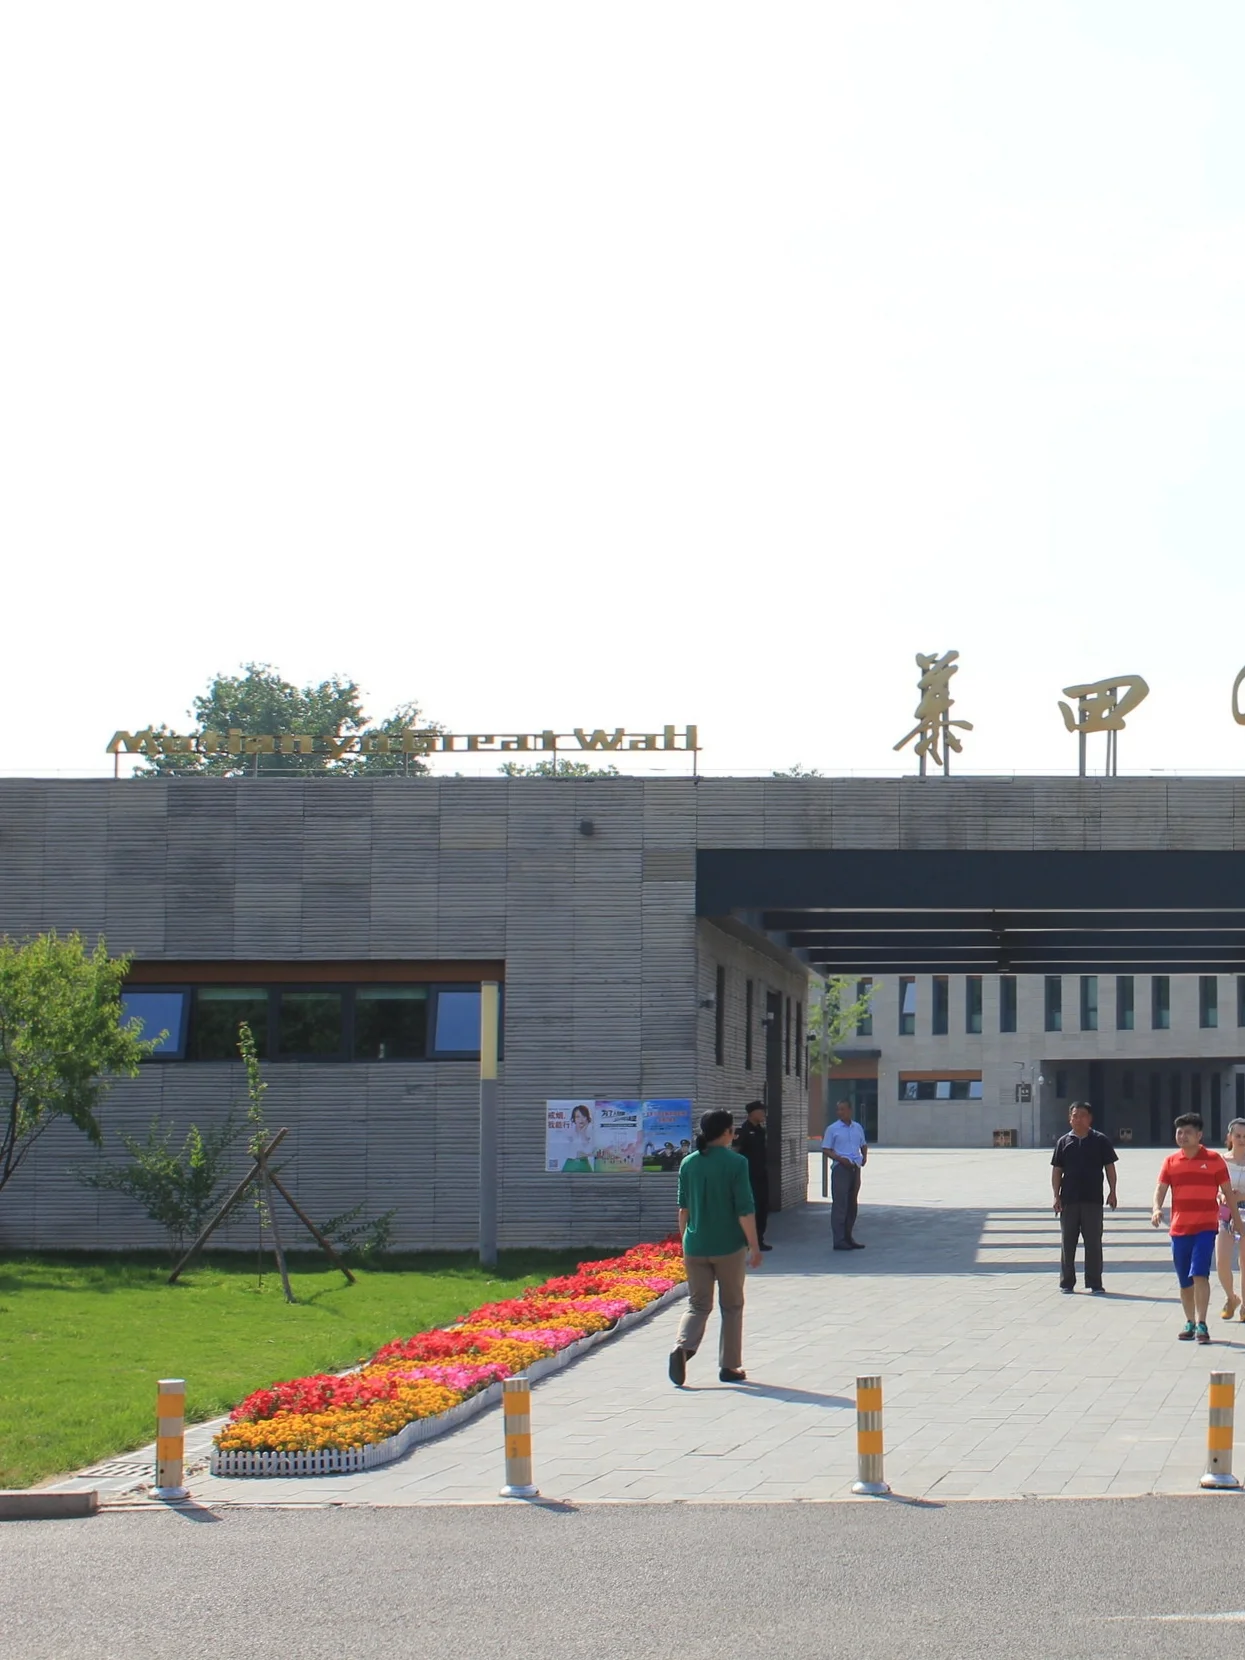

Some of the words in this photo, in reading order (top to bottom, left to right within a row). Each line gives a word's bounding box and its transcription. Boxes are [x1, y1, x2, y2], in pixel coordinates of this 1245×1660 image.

[106, 727, 391, 759] Mutianyu
[401, 728, 561, 753] Great
[574, 724, 702, 752] Wall
